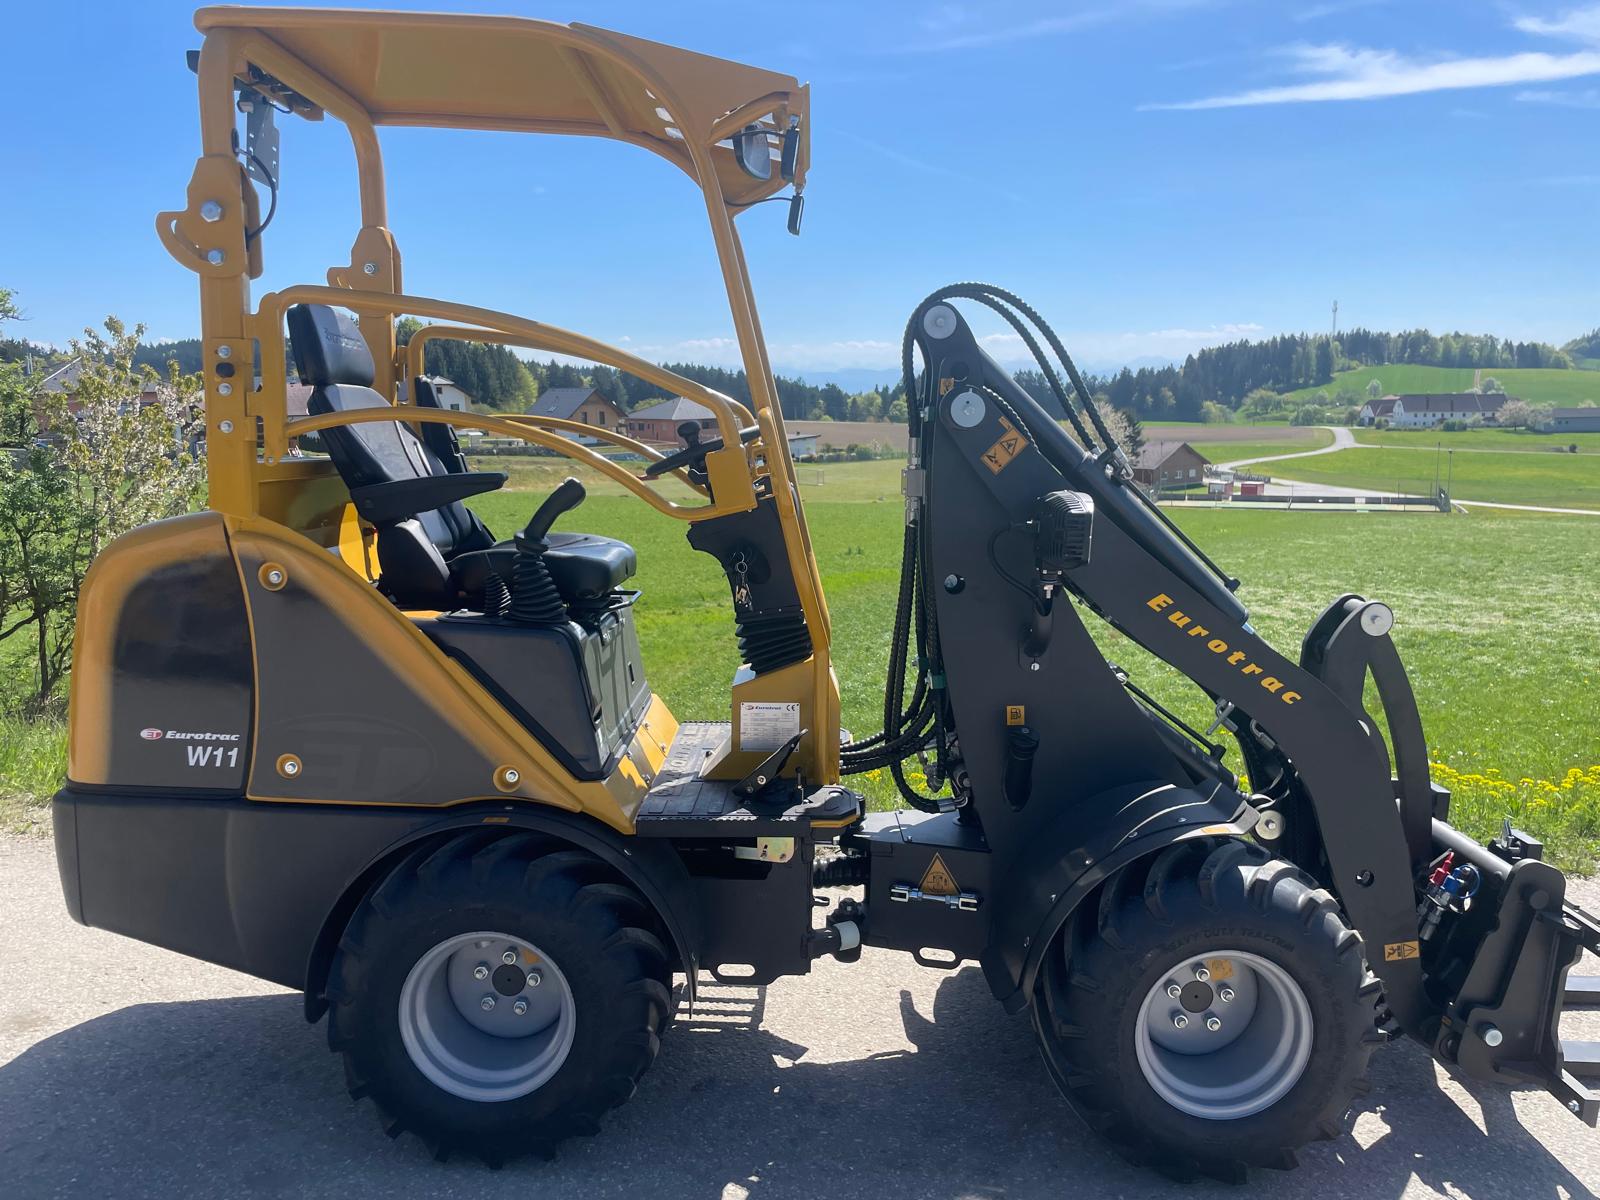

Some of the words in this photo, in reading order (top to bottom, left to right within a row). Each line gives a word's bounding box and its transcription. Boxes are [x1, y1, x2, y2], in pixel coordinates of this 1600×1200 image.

[1146, 593, 1302, 705] Eurotrac
[165, 730, 240, 741] Eurotrac
[187, 745, 239, 767] W11
[1204, 927, 1235, 938] DUTY
